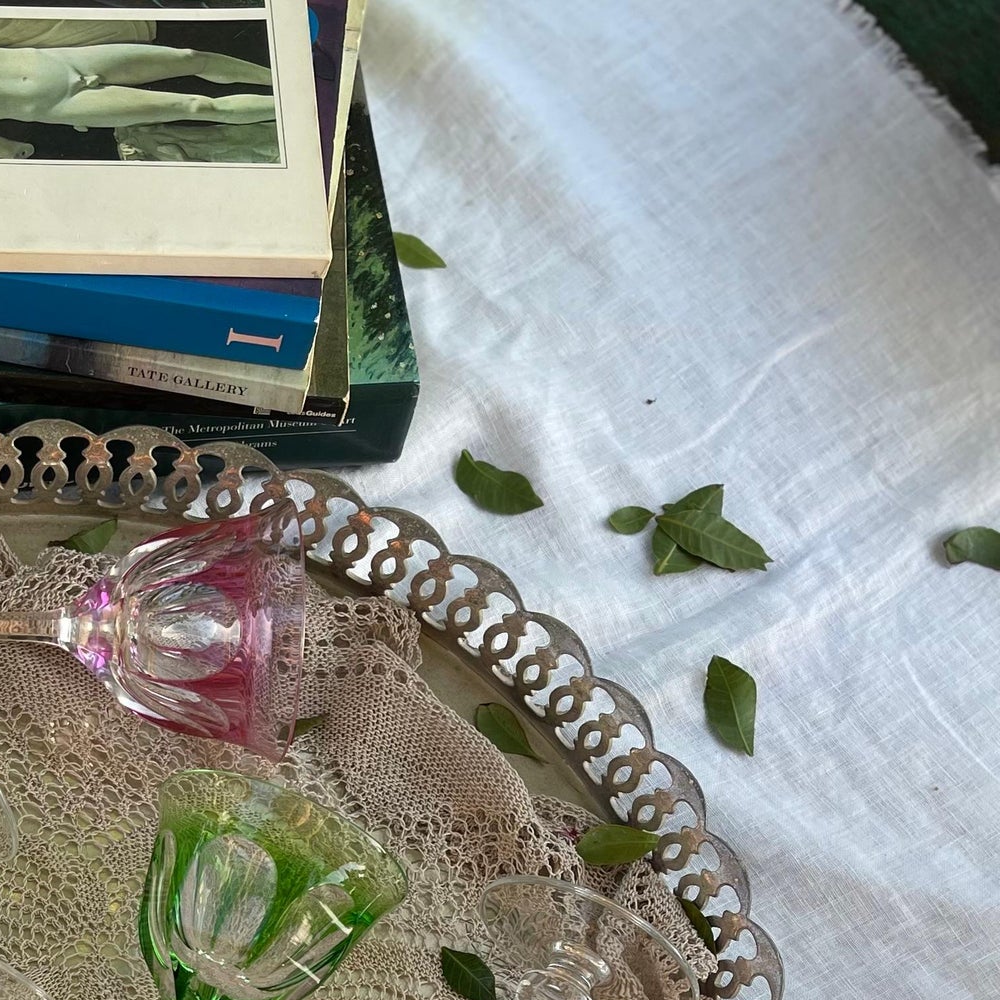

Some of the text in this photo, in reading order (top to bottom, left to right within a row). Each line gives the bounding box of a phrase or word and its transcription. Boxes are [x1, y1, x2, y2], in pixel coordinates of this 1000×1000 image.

[127, 366, 248, 397] TATE GALLERY
[162, 425, 185, 436] The
[189, 421, 265, 434] Metropolitan
